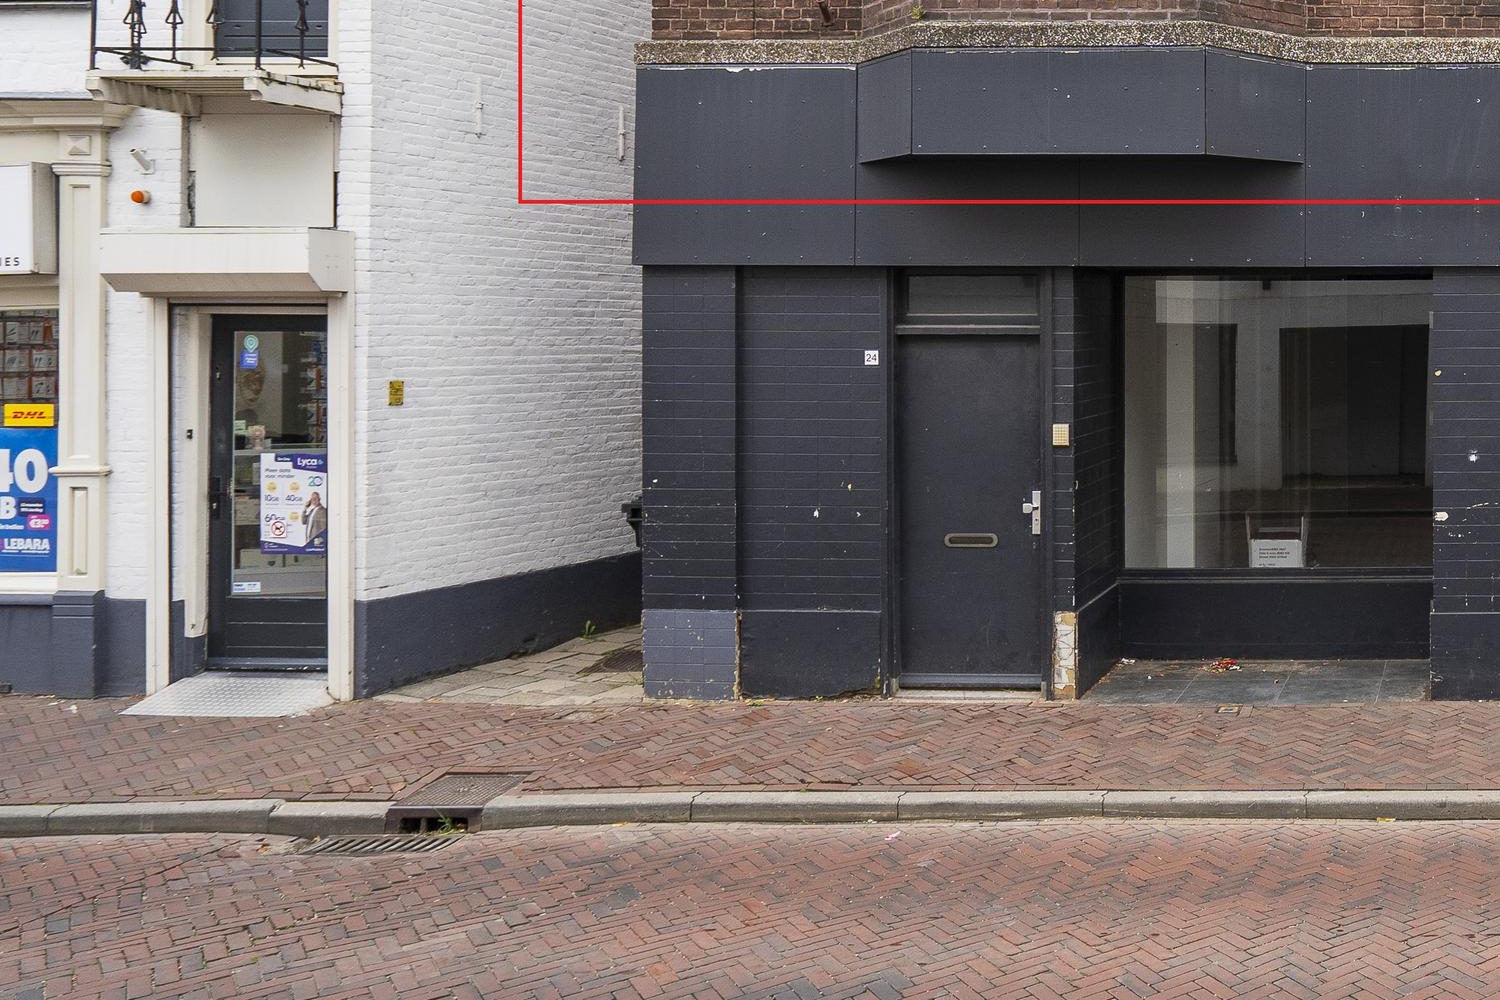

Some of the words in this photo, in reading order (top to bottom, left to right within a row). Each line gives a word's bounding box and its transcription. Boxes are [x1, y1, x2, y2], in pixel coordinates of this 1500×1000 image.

[866, 353, 877, 362] 24
[11, 411, 47, 419] DHL
[4, 538, 50, 550] LEBARA
